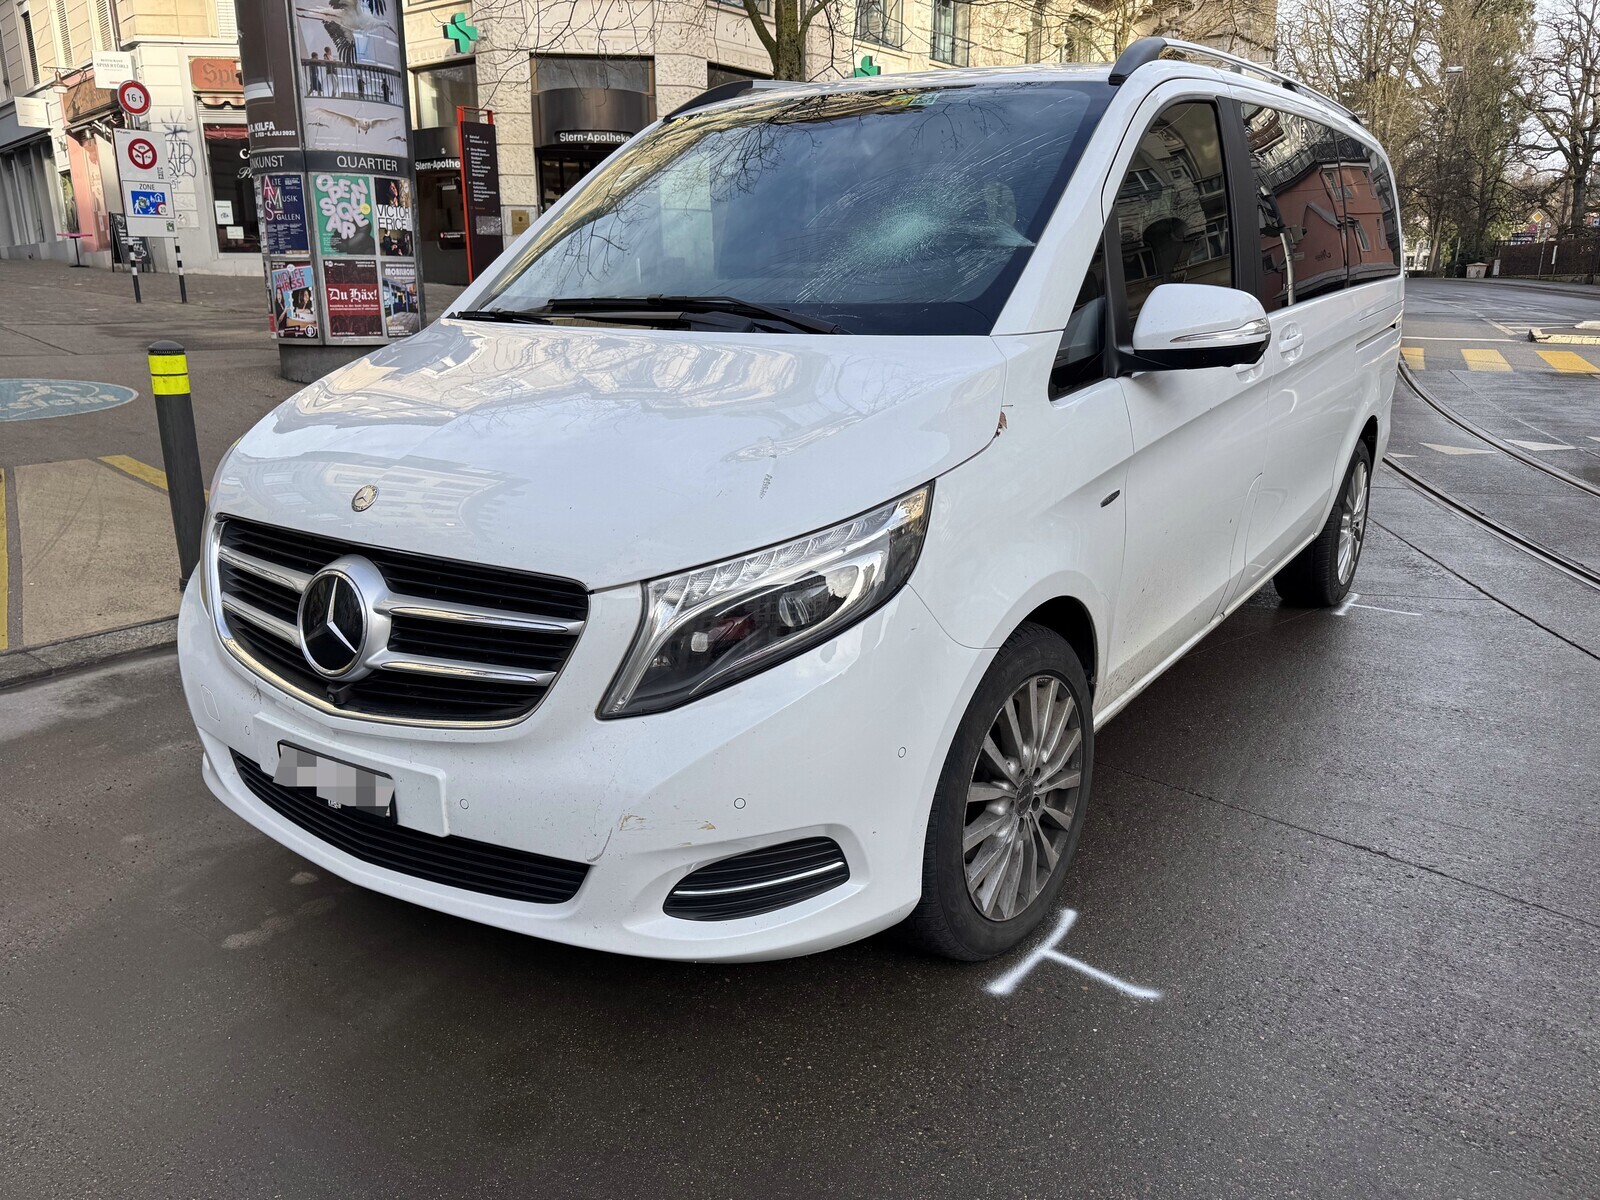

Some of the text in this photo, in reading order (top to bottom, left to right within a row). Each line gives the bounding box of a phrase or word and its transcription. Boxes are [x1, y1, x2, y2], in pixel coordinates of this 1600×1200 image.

[126, 93, 143, 104] 16 t
[336, 155, 398, 172] QUARTIER
[139, 183, 156, 191] ZONE
[377, 204, 411, 219] VICTOR
[328, 287, 349, 301] Du
